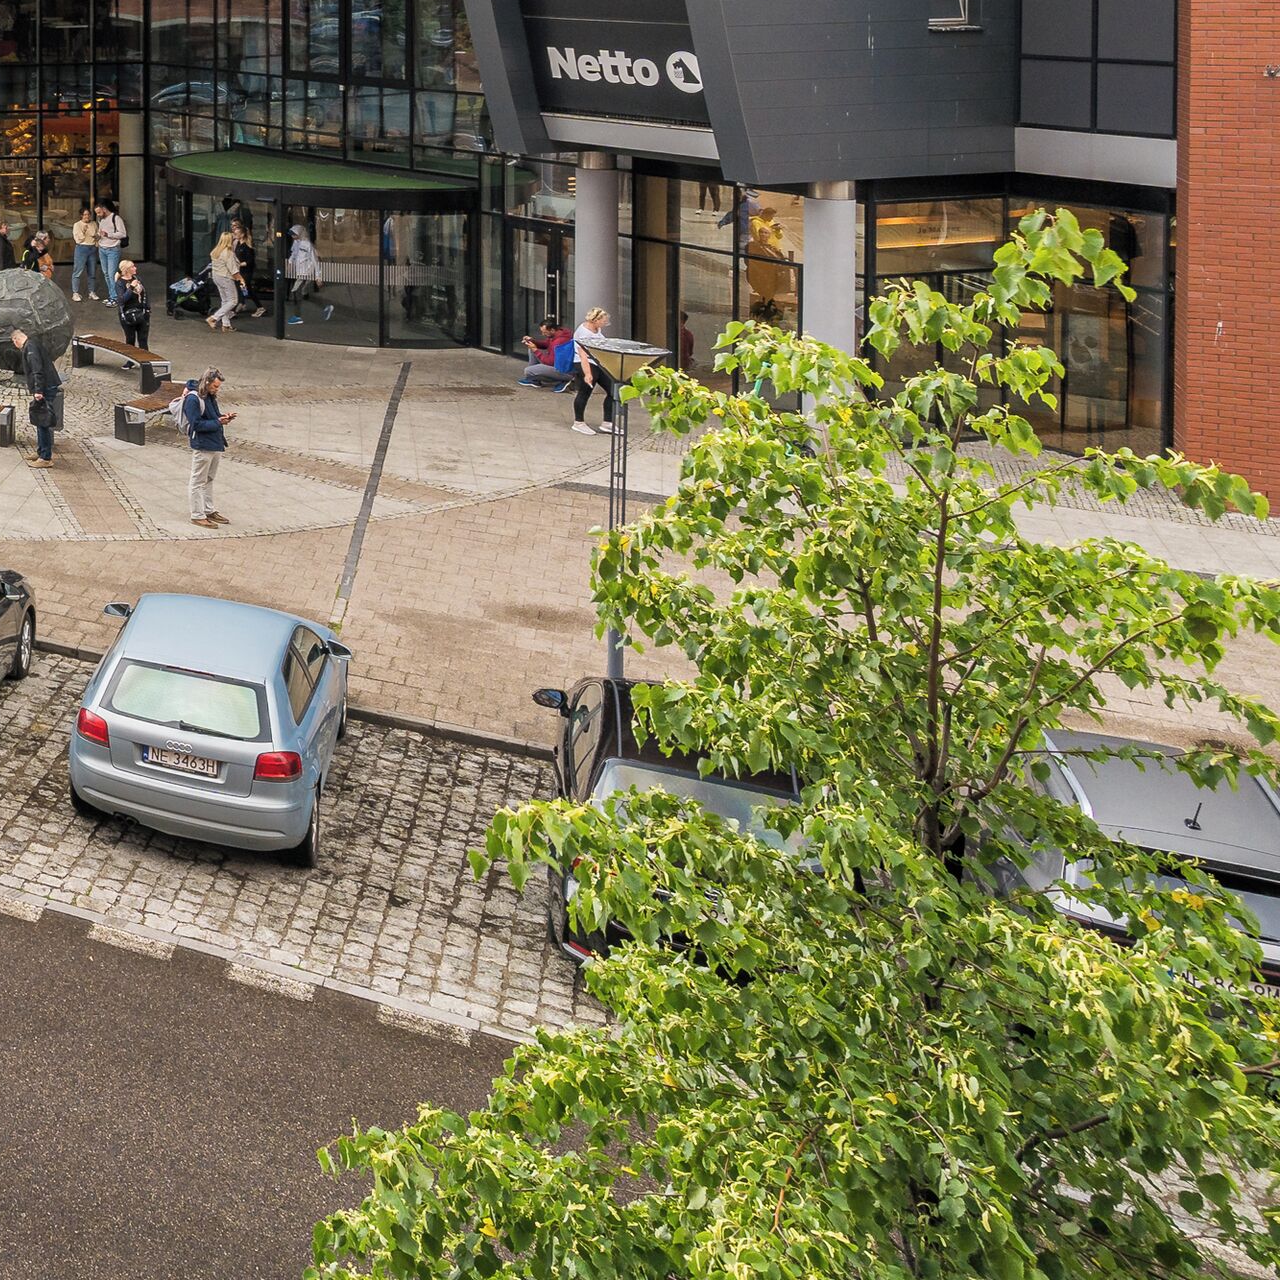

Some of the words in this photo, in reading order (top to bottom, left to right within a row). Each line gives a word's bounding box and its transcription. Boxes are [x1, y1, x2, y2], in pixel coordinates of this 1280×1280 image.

[546, 46, 660, 87] Netto
[151, 747, 169, 763] NE
[173, 752, 215, 773] 3463H
